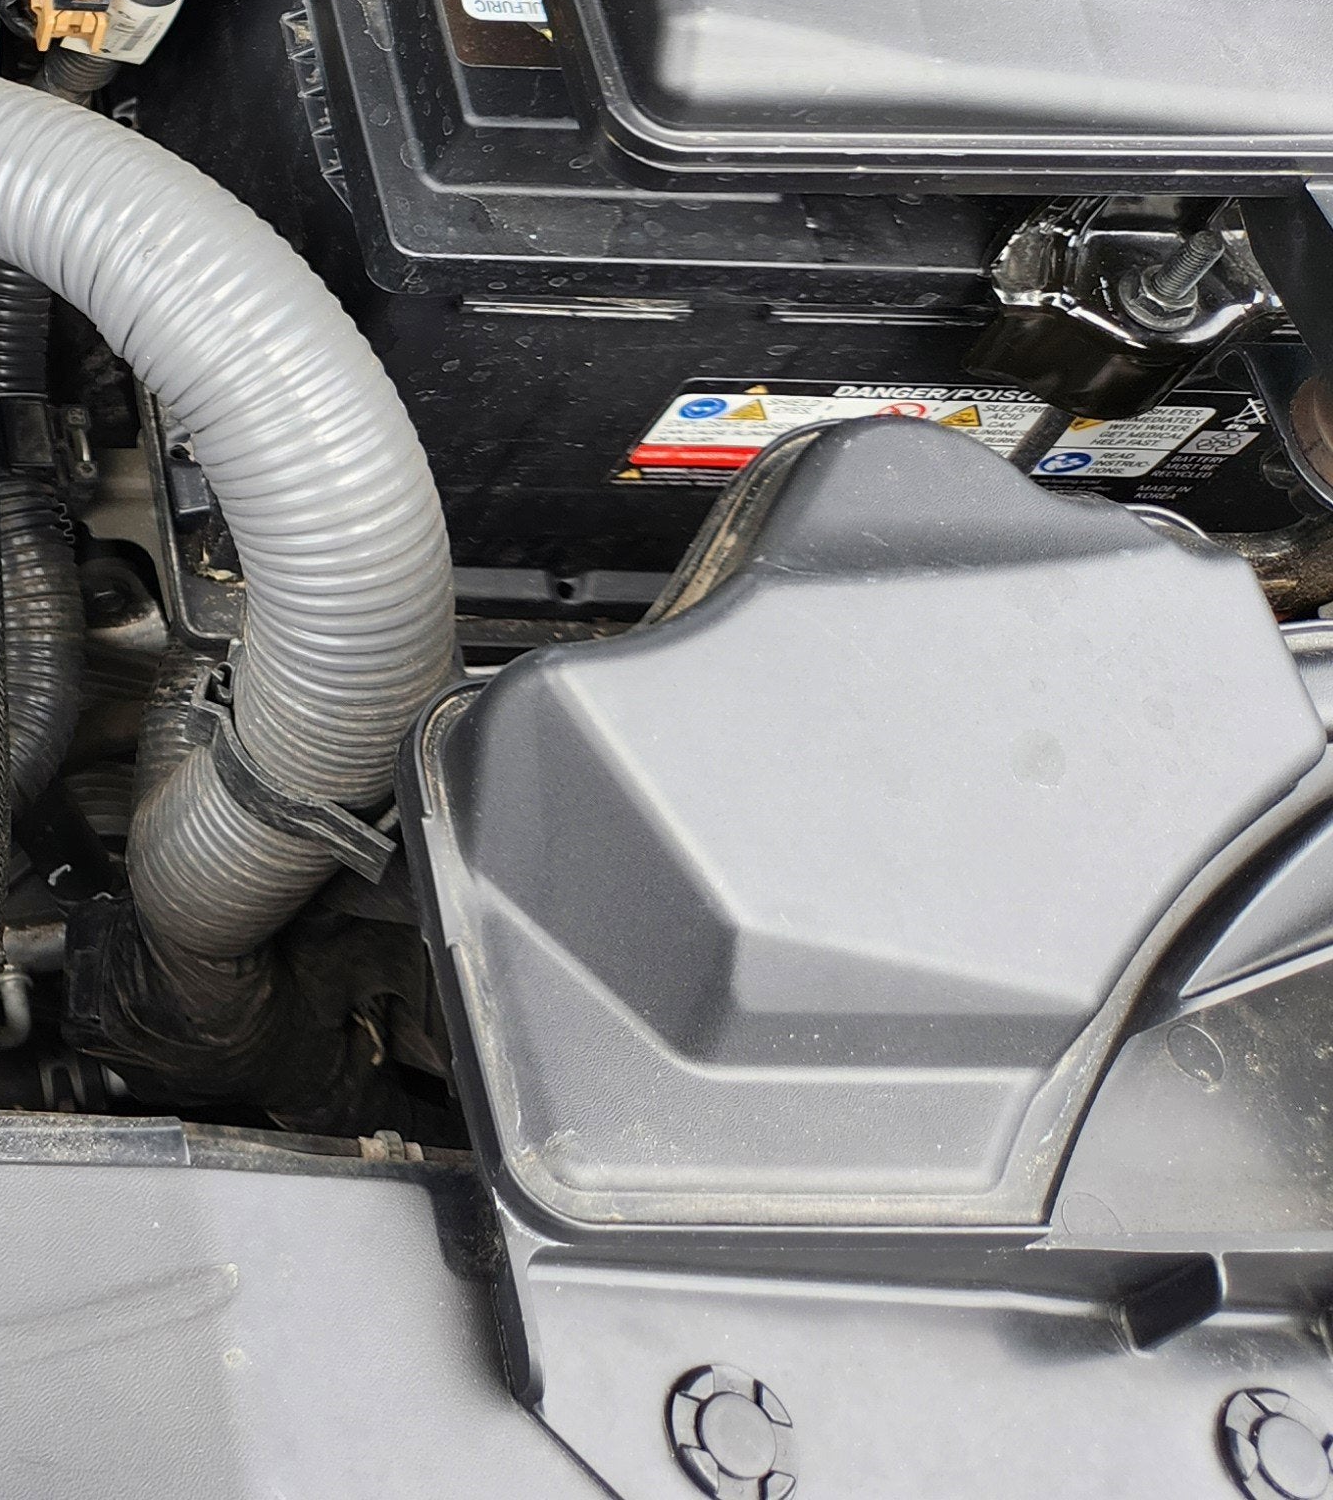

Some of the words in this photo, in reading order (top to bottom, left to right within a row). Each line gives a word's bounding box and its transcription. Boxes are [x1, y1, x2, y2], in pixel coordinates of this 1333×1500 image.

[832, 385, 1043, 402] DANGER/POISO
[987, 413, 1025, 421] ACID
[1108, 423, 1142, 431] WITH
[1128, 432, 1184, 440] MEDICAL
[1100, 452, 1136, 460] READ
[1171, 455, 1229, 464] BATTERY
[1163, 463, 1199, 471] MUST
[1150, 470, 1214, 479] RECYCLED
[1175, 485, 1194, 493] IN
[1133, 492, 1178, 500] KOREA
